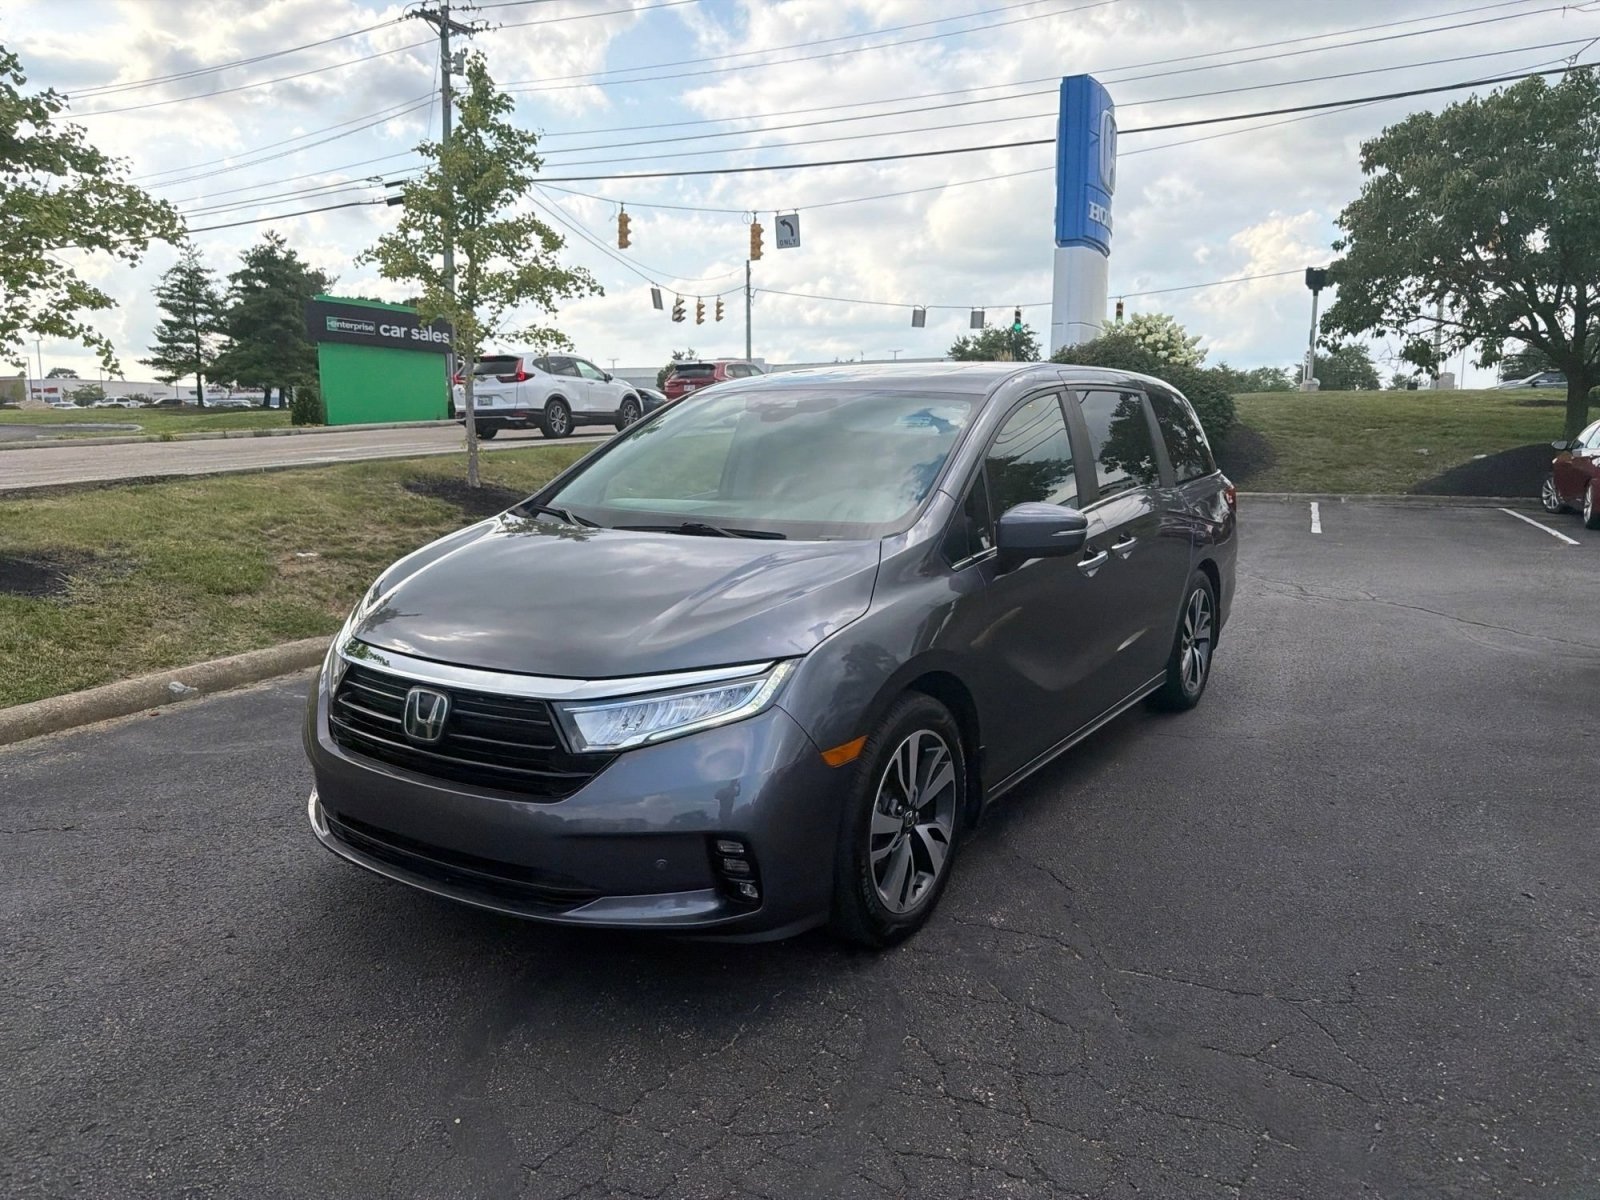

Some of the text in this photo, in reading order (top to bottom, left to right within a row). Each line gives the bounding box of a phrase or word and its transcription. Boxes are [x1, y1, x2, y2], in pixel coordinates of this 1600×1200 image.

[328, 320, 450, 343] enterprise car sales
